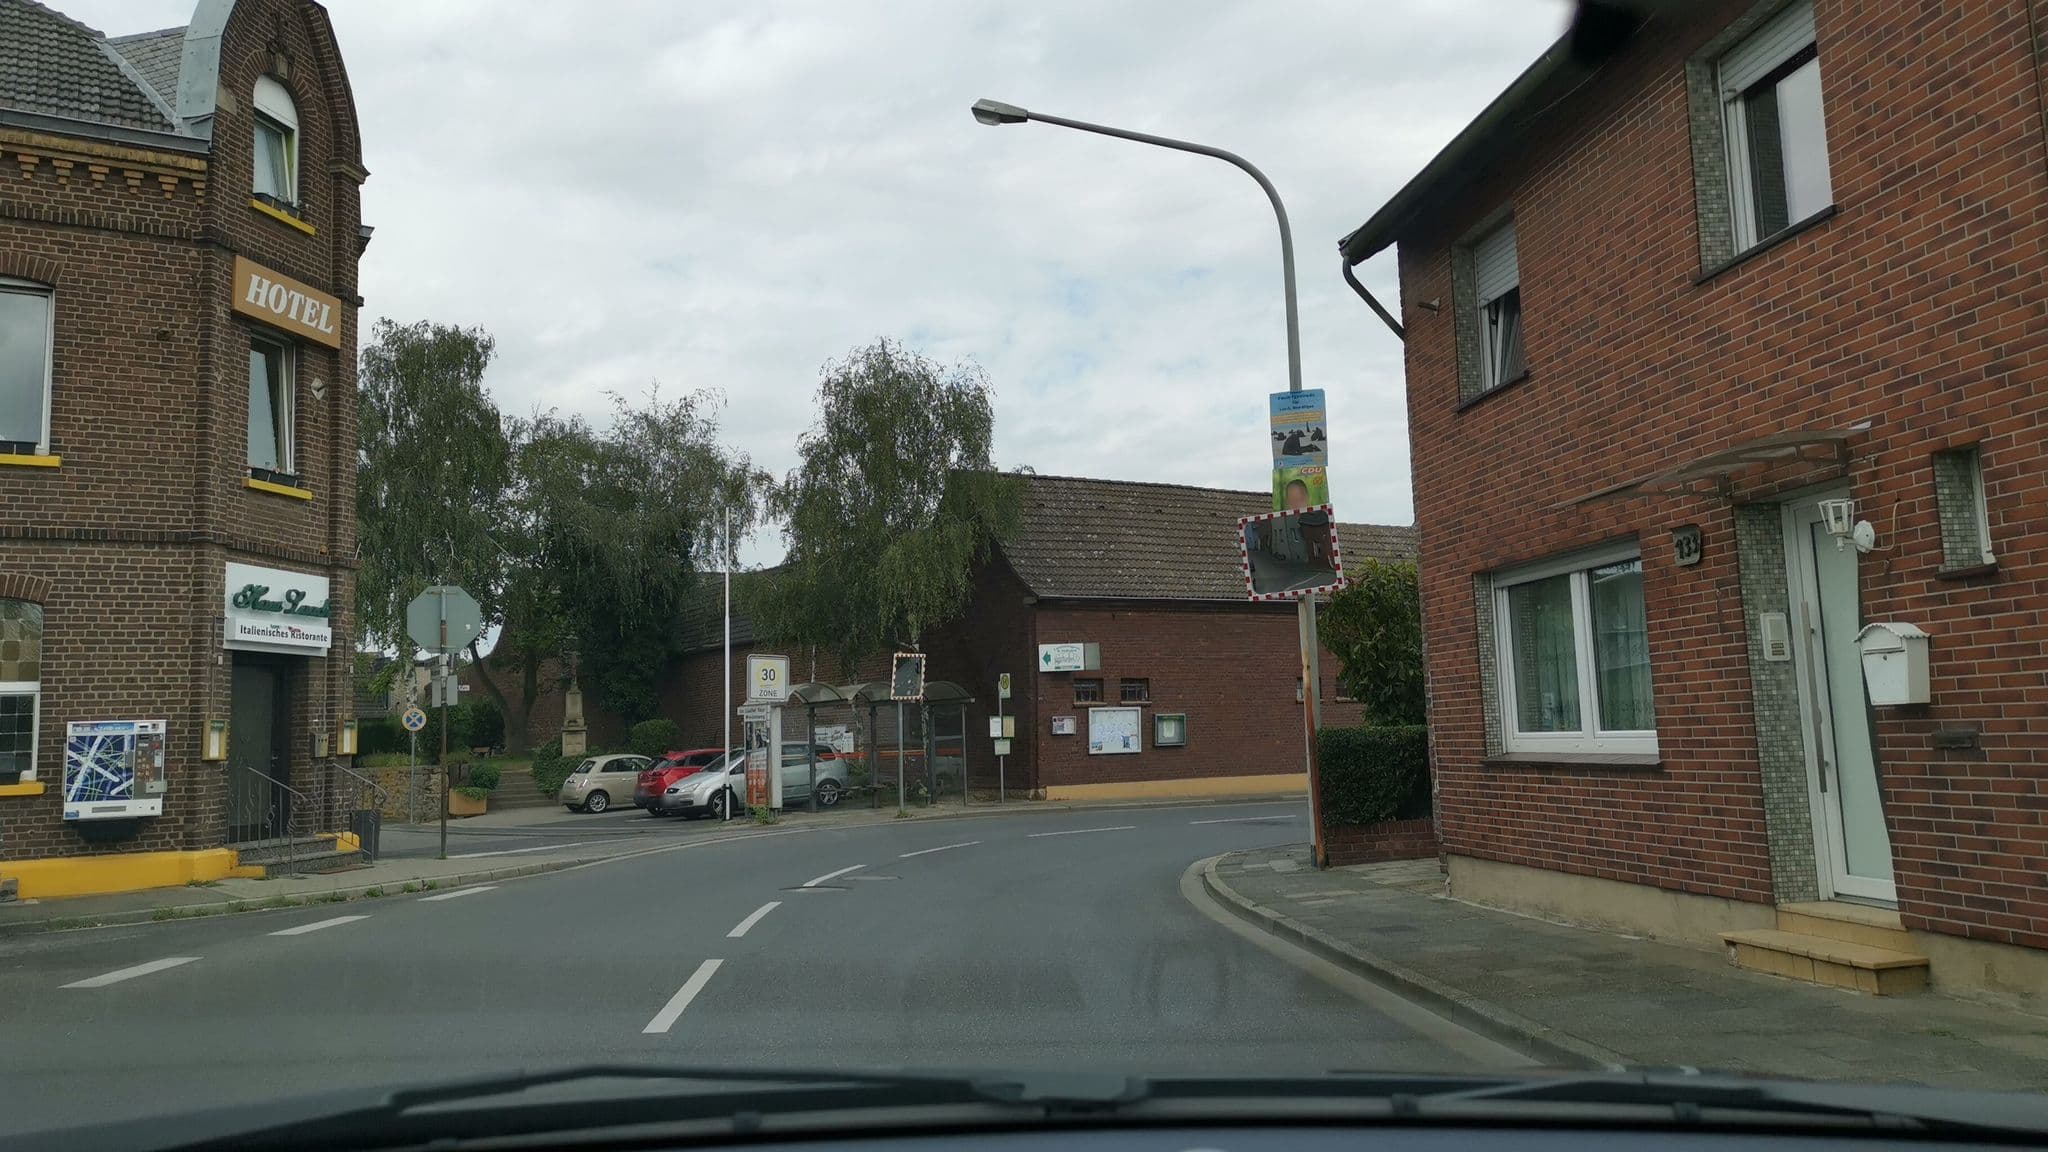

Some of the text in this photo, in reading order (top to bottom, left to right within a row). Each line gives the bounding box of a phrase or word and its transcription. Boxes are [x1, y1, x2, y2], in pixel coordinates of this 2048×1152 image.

[245, 273, 334, 334] HOTEL
[1676, 535, 1698, 559] 133
[240, 624, 289, 639] Italienisches
[290, 630, 328, 643] Ristorante
[761, 668, 776, 681] 30
[758, 689, 778, 697] ZONE
